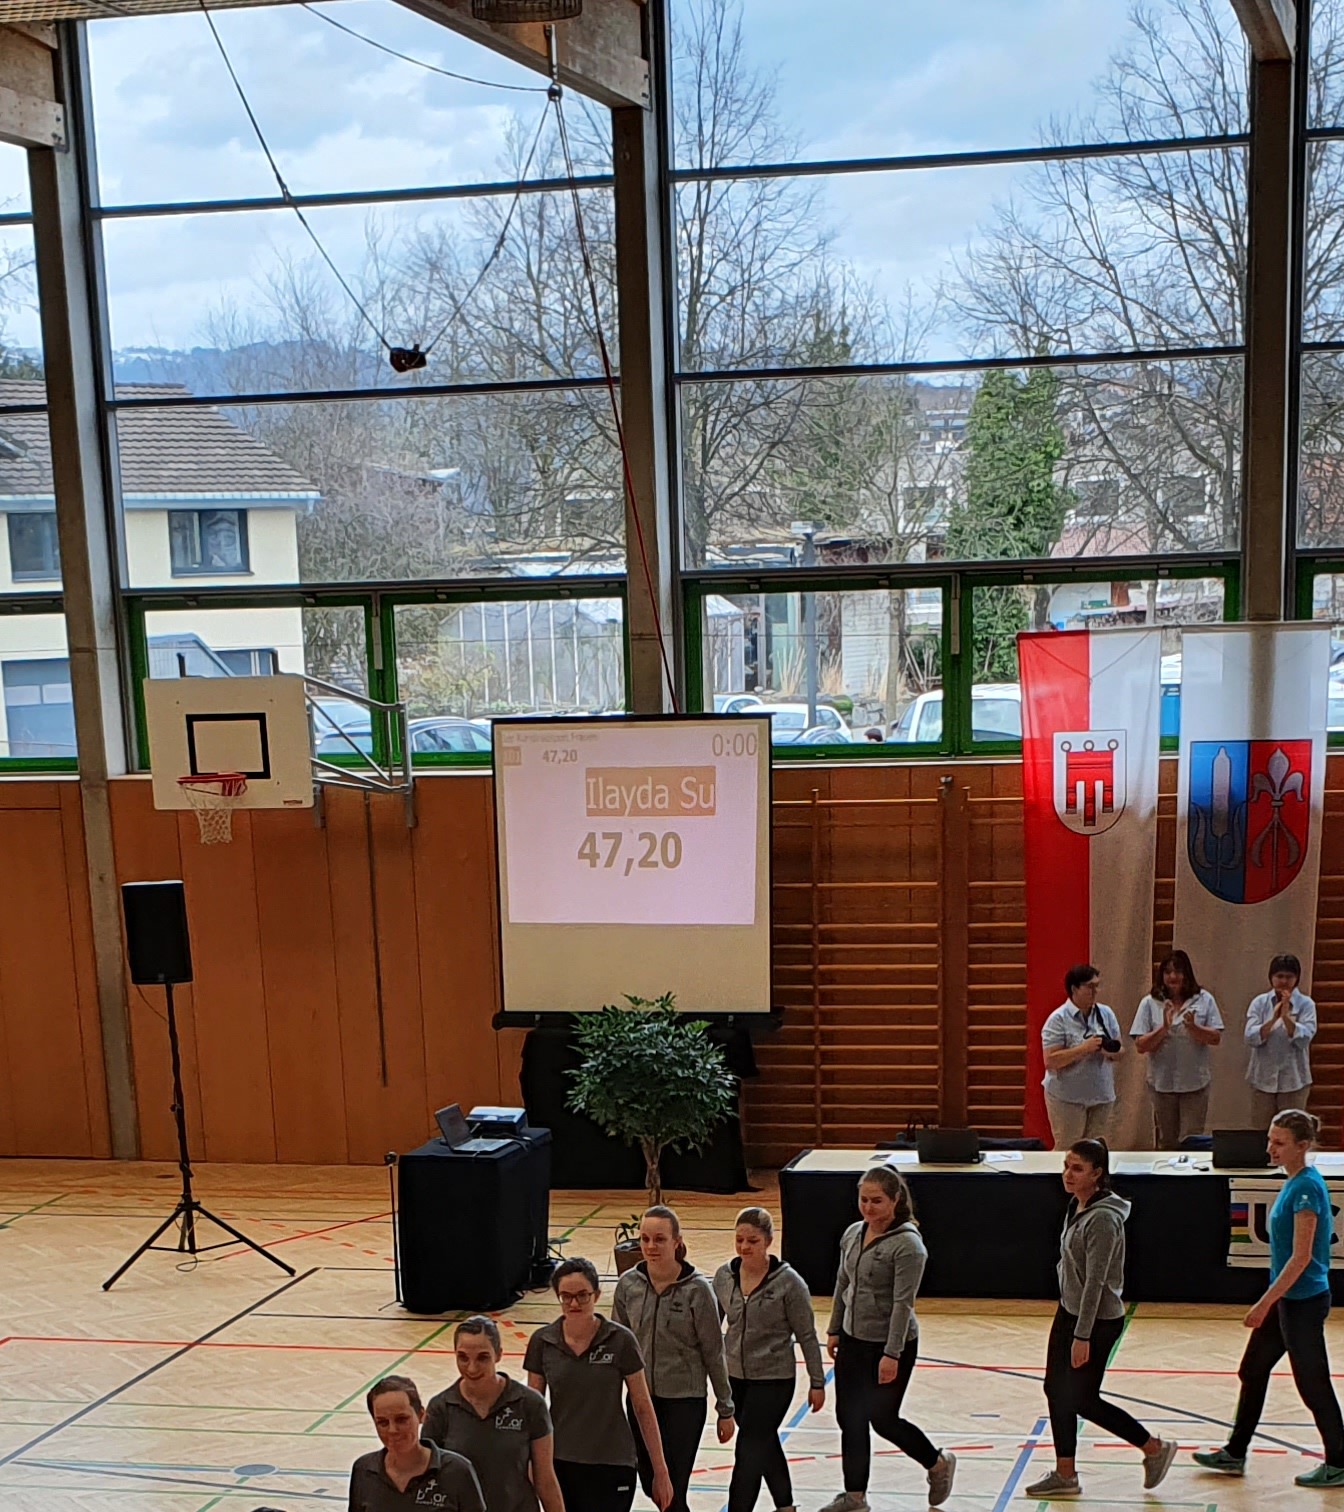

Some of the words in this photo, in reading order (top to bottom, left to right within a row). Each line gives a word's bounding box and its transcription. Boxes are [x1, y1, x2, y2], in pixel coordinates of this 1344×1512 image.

[542, 749, 578, 764] 47,20
[712, 733, 757, 757] 0:00
[587, 776, 669, 816] Ilayda
[680, 776, 716, 809] Su
[577, 831, 683, 876] 47,20
